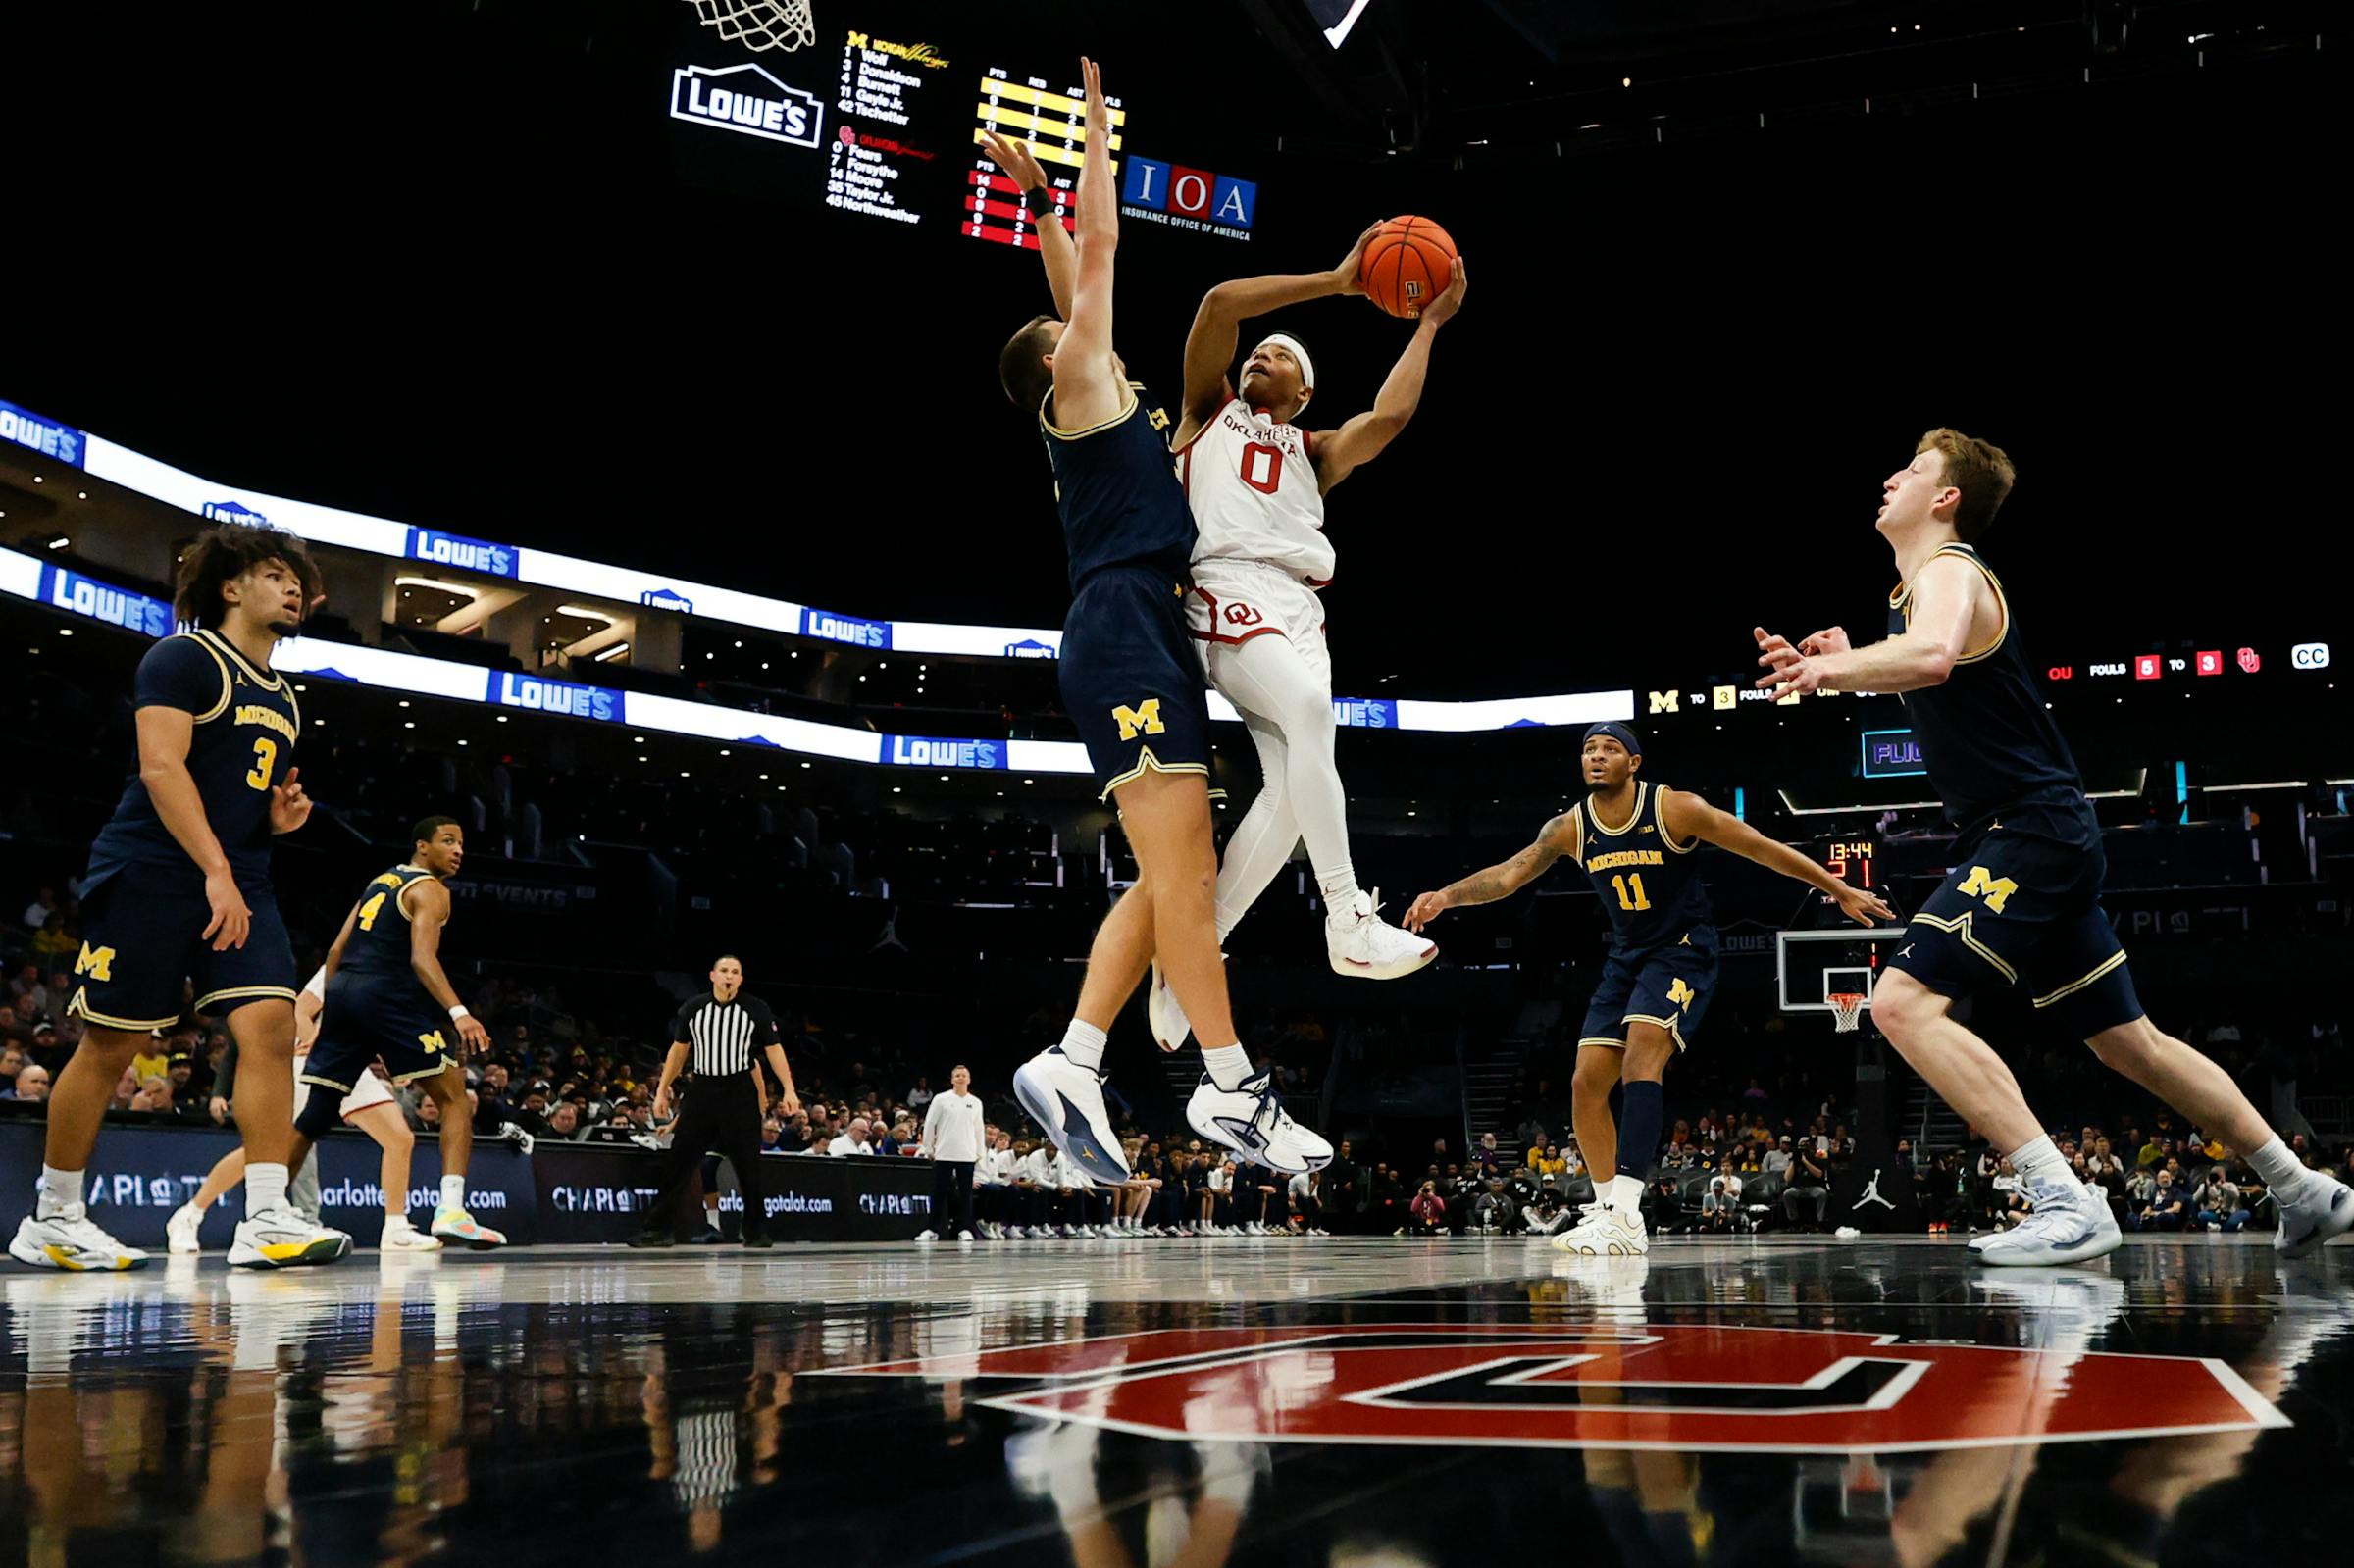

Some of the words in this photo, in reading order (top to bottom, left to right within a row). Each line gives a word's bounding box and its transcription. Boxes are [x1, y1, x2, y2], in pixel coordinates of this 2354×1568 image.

[844, 46, 851, 57] 1
[861, 49, 889, 66] Wolf
[841, 72, 850, 83] 4
[857, 75, 901, 96] Burnett
[843, 59, 852, 71] 3
[859, 62, 921, 88] Donaldson
[989, 67, 1007, 79] PTS
[1028, 76, 1047, 89] REB
[1067, 86, 1084, 98] AST
[1105, 96, 1121, 108] FLS
[688, 77, 807, 136] LOWE'S
[838, 99, 854, 113] 42
[854, 102, 909, 126] Tschetter
[840, 85, 851, 98] 11
[856, 88, 890, 107] Gayle
[890, 97, 904, 111] Jr.
[1033, 106, 1040, 116] 1
[1068, 114, 1077, 126] 2
[848, 144, 882, 163] Fears
[1028, 130, 1037, 142] 2
[1064, 139, 1074, 151] 2
[830, 167, 844, 179] 14
[845, 170, 884, 188] Moore
[831, 154, 840, 166] 7
[847, 157, 898, 179] Forsythe
[976, 160, 995, 172] PTS
[1053, 177, 1072, 189] AST
[827, 179, 844, 194] 35
[844, 182, 880, 202] Taylor
[879, 191, 894, 205] Jr.
[976, 174, 991, 187] 14
[1056, 192, 1066, 204] 3
[976, 187, 987, 199] 0
[1020, 196, 1027, 208] 1
[1054, 205, 1064, 216] 0
[1138, 164, 1247, 222] IOA
[826, 194, 843, 207] 45
[843, 196, 920, 224] Northweather
[1016, 208, 1026, 221] 3
[1122, 206, 1168, 224] INSURANCE
[1170, 217, 1199, 230] OFFICE
[1202, 223, 1212, 233] OF
[1213, 226, 1251, 241] AMERICA
[971, 225, 981, 237] 2
[1012, 234, 1022, 246] 2
[1015, 221, 1024, 233] 2
[0, 410, 78, 463] OWE'S
[1241, 441, 1284, 495] 0
[417, 531, 510, 575] LOWE'S
[53, 568, 165, 637] LOWE'S
[808, 611, 884, 648] LOWE'S
[2049, 667, 2072, 681] OU
[2089, 663, 2126, 677] FOULS
[2141, 661, 2153, 675] 5
[2169, 659, 2185, 671] TO
[2202, 656, 2215, 670] 3
[2296, 649, 2325, 666] CC
[501, 672, 612, 721] LOWE'S
[1649, 689, 1679, 714] M
[1690, 693, 1705, 705] TO
[1719, 691, 1729, 703] 3
[1111, 698, 1165, 742] M
[246, 737, 277, 791] 3
[893, 736, 996, 768] LOWE'S
[1586, 850, 1663, 873] MICHIGAN
[1830, 842, 1872, 860] 13:44
[1612, 873, 1651, 911] 11
[1957, 865, 2019, 914] M
[358, 892, 386, 932] 4
[74, 940, 116, 981] M
[1665, 977, 1695, 1014] M
[418, 1030, 447, 1054] M
